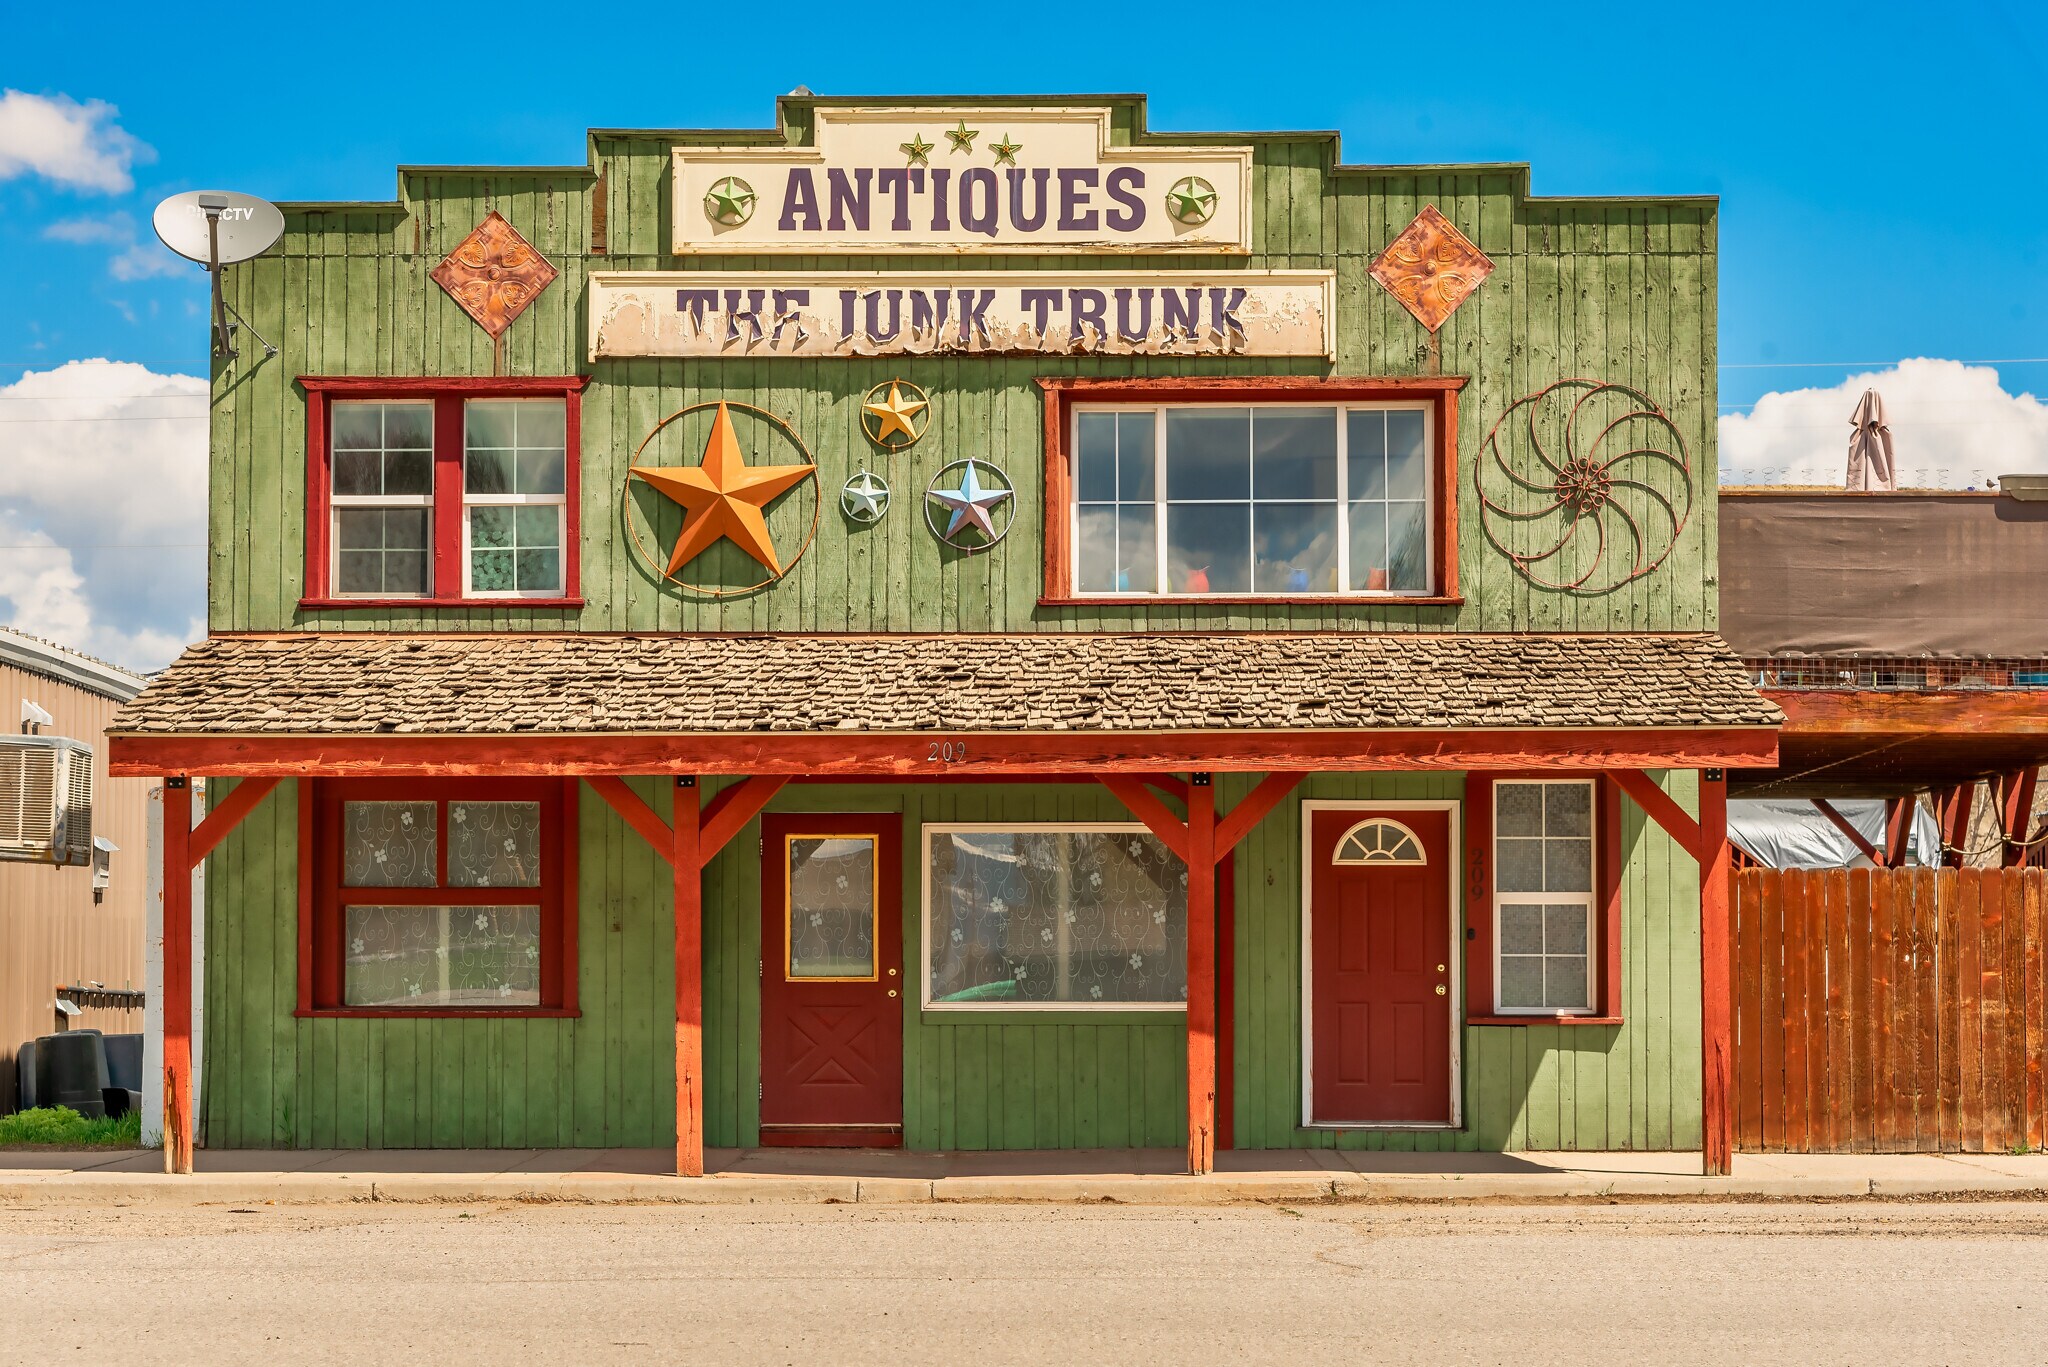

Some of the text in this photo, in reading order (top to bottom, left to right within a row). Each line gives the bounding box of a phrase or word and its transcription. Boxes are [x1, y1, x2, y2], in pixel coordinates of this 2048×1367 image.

[777, 166, 1147, 238] ANTIQUES
[676, 288, 1248, 345] THE JUNK TRUNK
[927, 741, 967, 764] 209
[1471, 847, 1484, 902] 209
